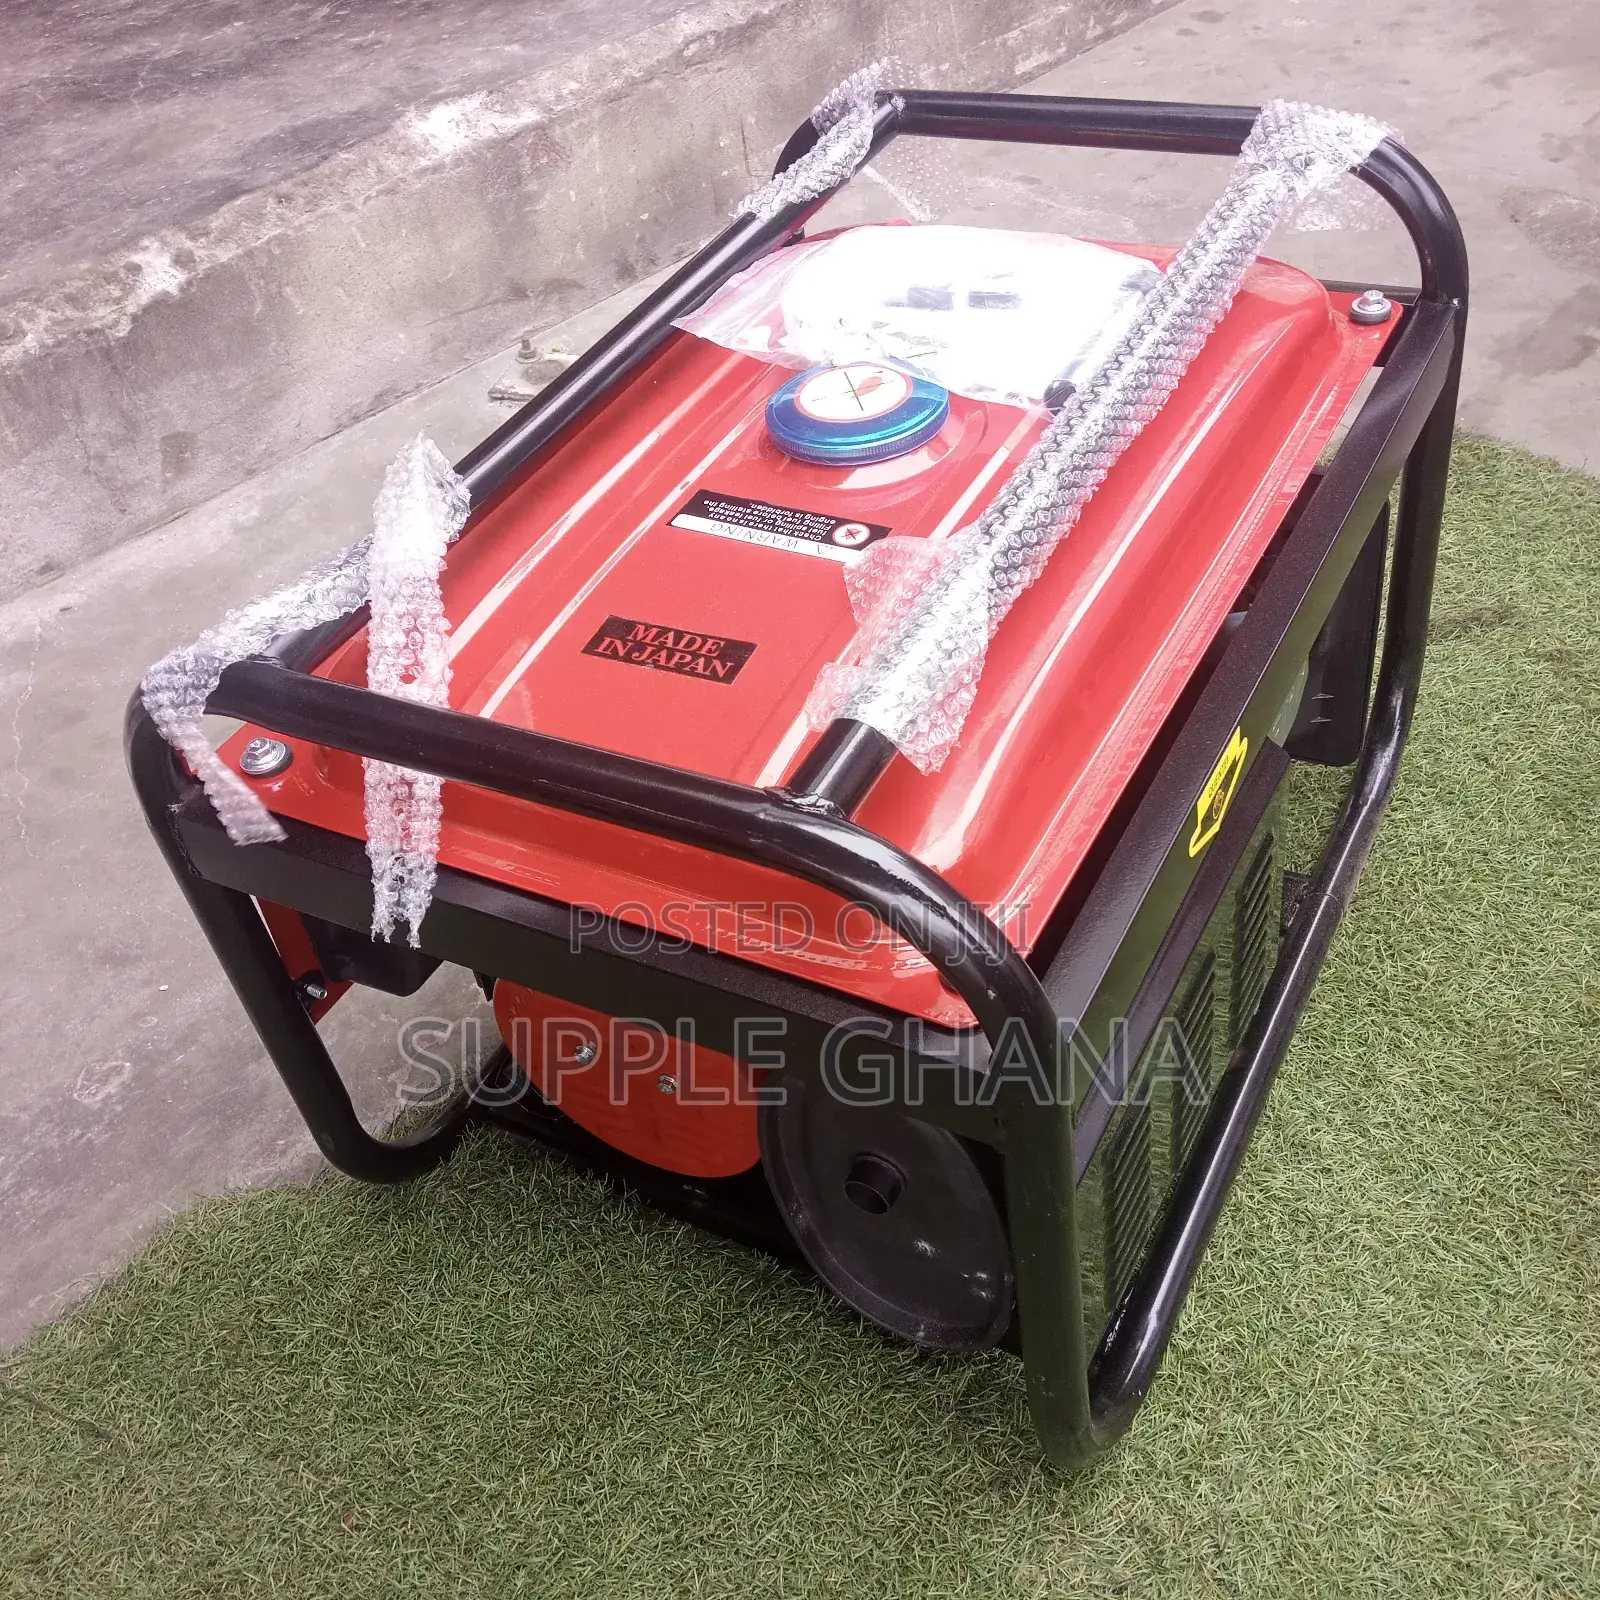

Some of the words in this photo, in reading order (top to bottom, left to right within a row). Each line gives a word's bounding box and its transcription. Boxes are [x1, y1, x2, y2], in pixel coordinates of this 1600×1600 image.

[703, 499, 718, 507] the
[753, 510, 782, 520] before
[748, 521, 773, 531] there
[775, 520, 808, 531] spilling
[711, 523, 798, 548] WARNING
[774, 527, 793, 535] that
[793, 530, 822, 541] Check
[808, 528, 827, 536] fuel
[626, 624, 726, 657] MADE
[594, 637, 631, 657] IN
[632, 646, 734, 678] JAPAN
